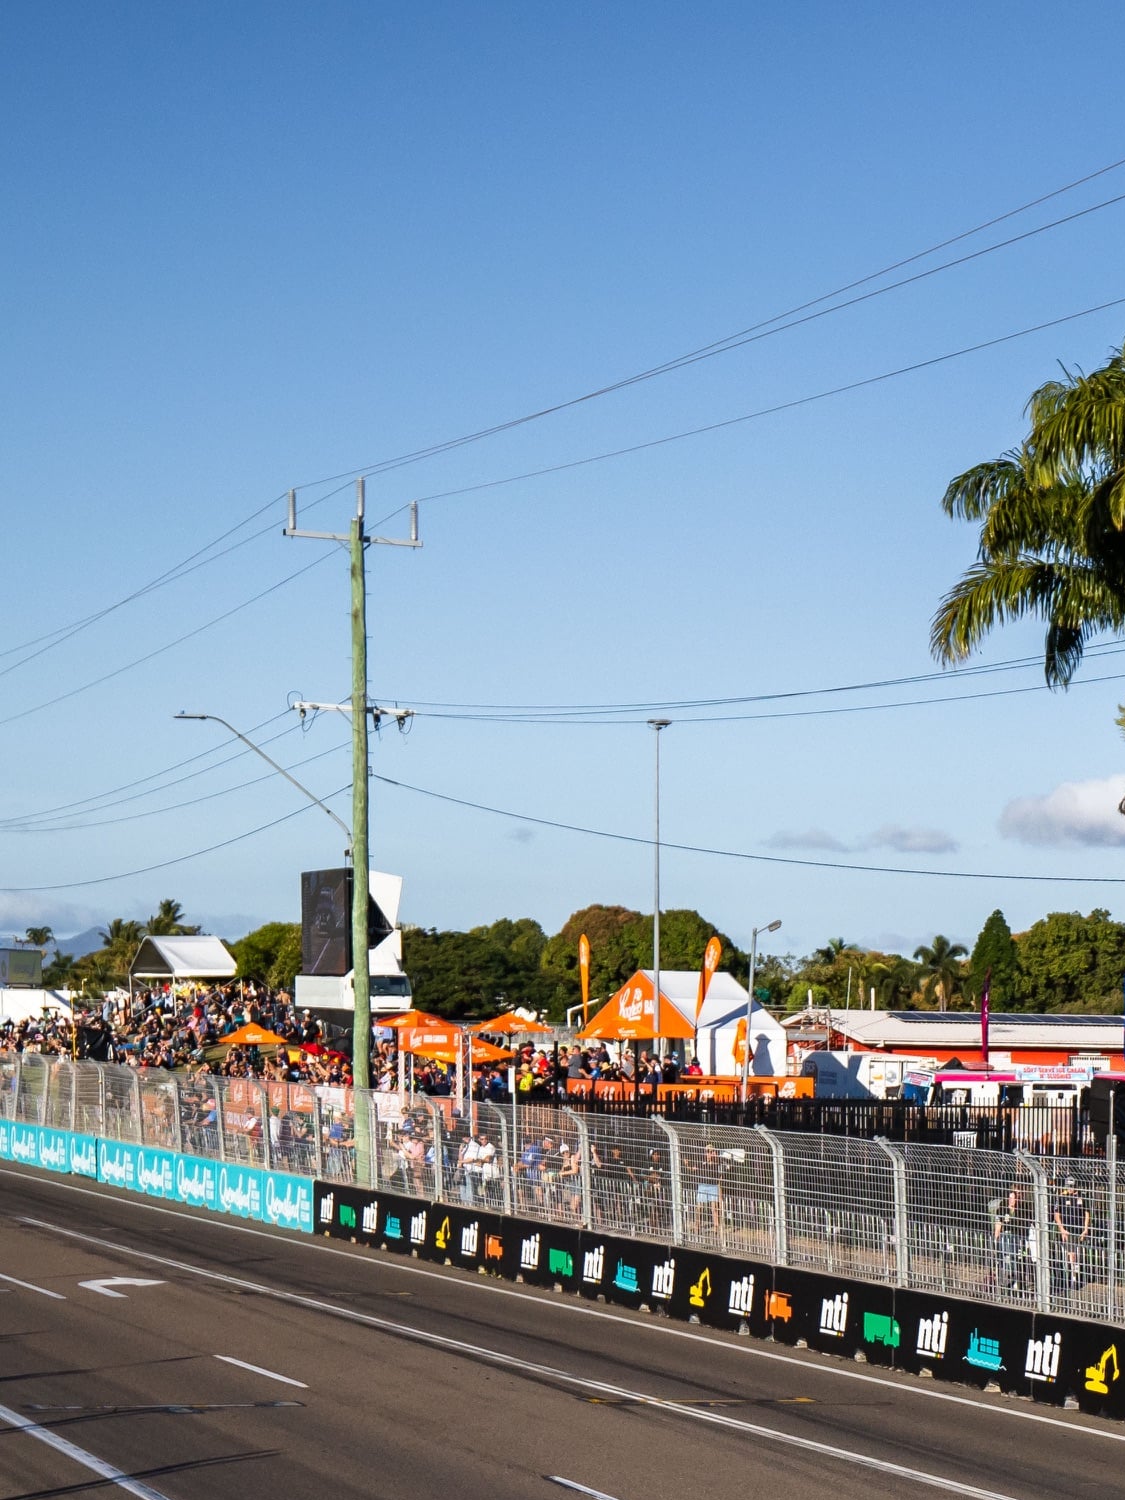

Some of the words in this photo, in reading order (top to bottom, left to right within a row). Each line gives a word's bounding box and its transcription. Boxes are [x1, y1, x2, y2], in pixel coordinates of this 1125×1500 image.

[461, 1221, 479, 1253] nti
[521, 1233, 541, 1266] nti
[583, 1245, 604, 1279] nti
[652, 1258, 676, 1296] nti
[729, 1274, 755, 1312] nti
[820, 1292, 849, 1332] nti
[917, 1311, 949, 1354] nti
[1025, 1332, 1062, 1377] nti
